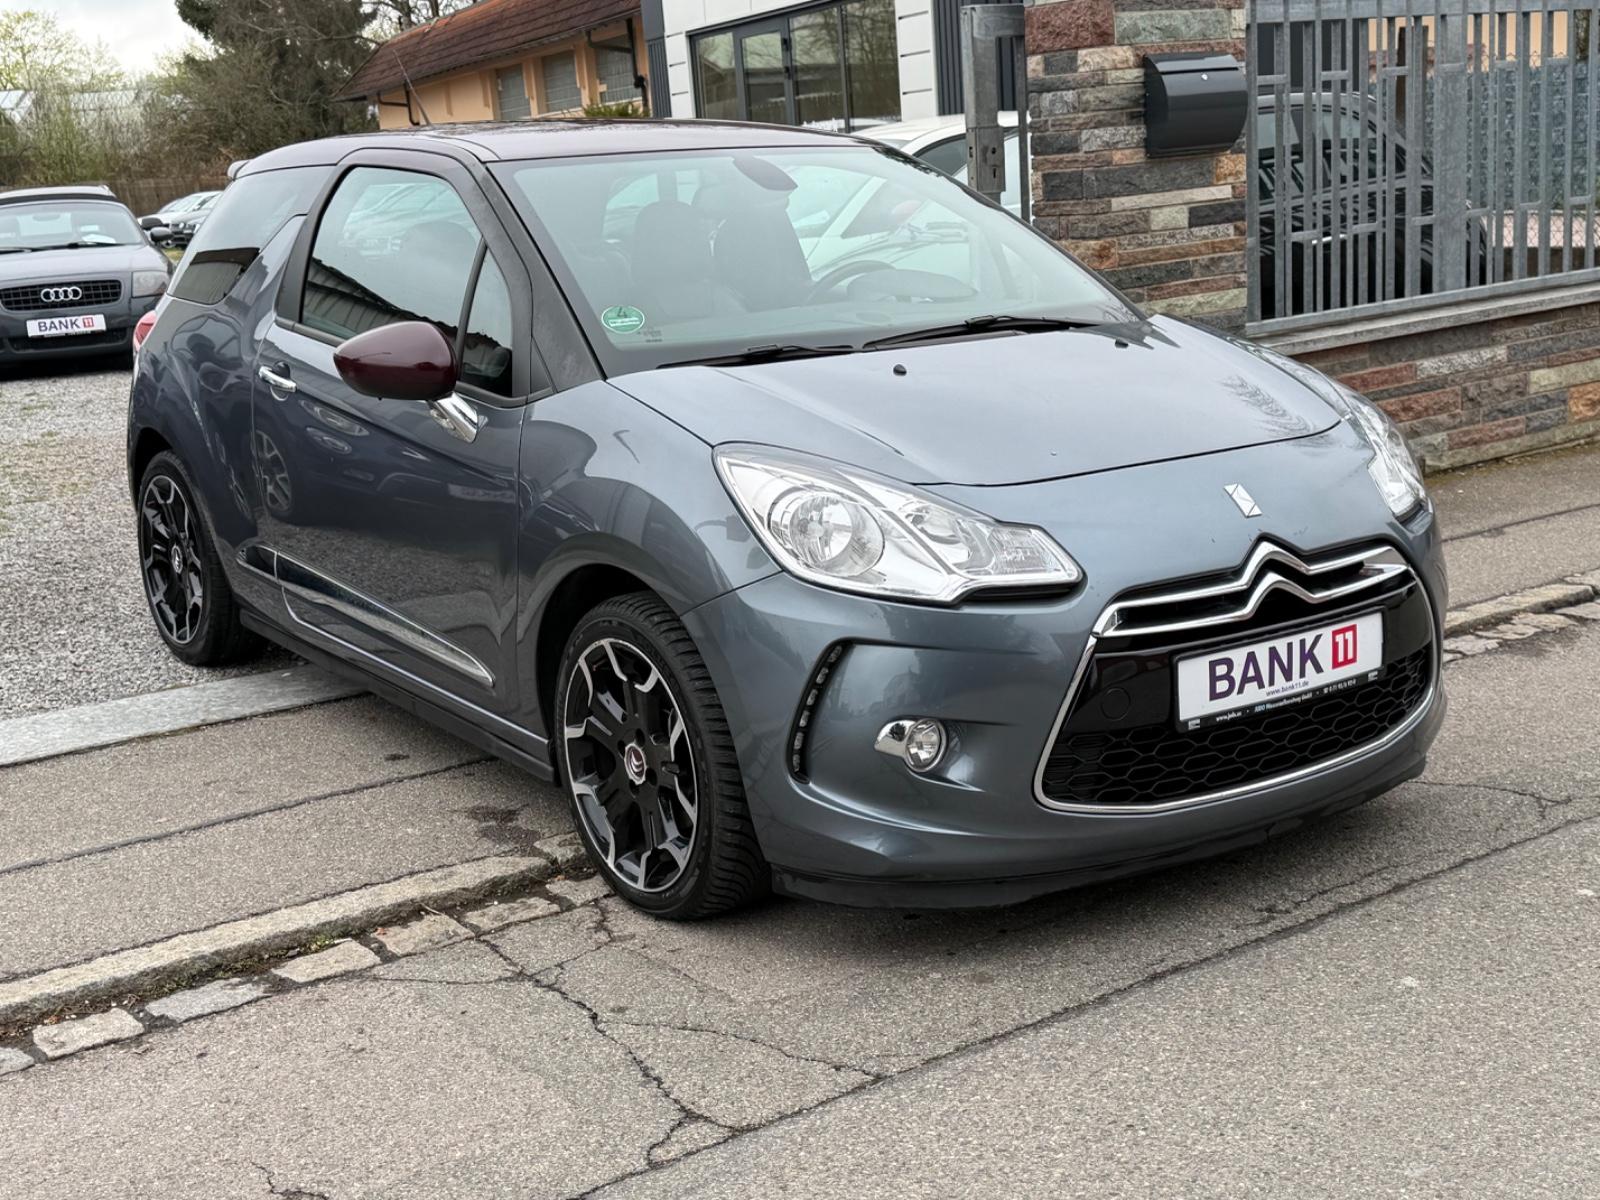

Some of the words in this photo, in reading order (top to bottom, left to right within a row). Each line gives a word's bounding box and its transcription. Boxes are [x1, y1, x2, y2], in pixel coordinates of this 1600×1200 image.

[37, 318, 81, 332] BANK
[82, 318, 94, 328] 11
[1208, 633, 1325, 701] BANK
[1334, 628, 1355, 666] 11
